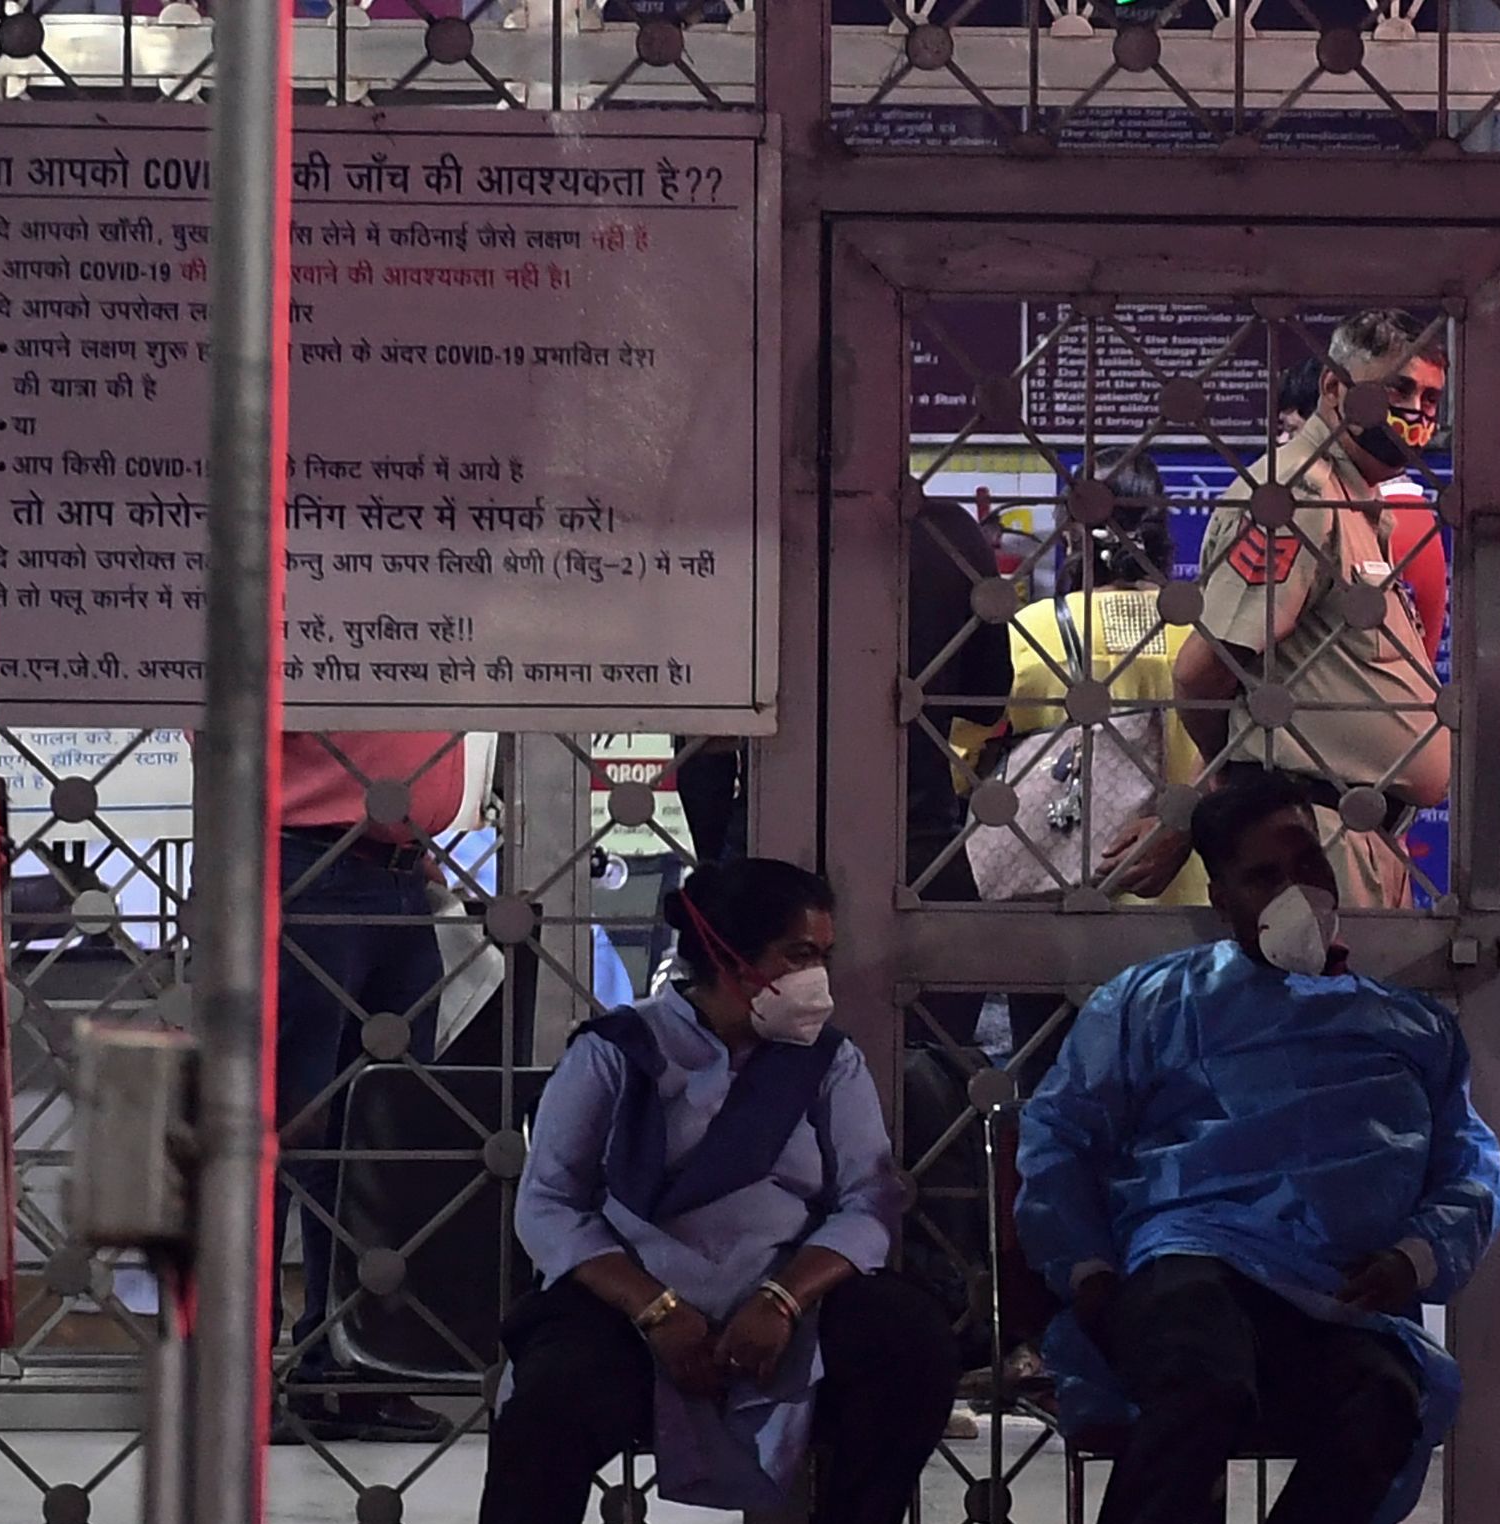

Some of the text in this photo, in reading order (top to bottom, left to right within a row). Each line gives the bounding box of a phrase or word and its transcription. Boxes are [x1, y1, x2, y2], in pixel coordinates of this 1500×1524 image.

[28, 147, 129, 188] आपको
[144, 158, 209, 190] COVI
[423, 153, 462, 195] की
[477, 164, 644, 198] आवश्यकता
[21, 214, 88, 241] आपको
[321, 219, 356, 246] लेने
[366, 219, 380, 247] में
[389, 220, 468, 252] कठिनाई
[477, 221, 516, 249] जैसे
[525, 228, 581, 249] लक्षण
[2, 255, 71, 282] आपको
[79, 260, 172, 283] COVID-19
[347, 258, 374, 286] की
[383, 264, 495, 289] आवश्यकता
[22, 292, 90, 320] आपको
[100, 294, 179, 322] उपरोक्त
[14, 331, 71, 359] आपने
[80, 338, 136, 360] लक्षण
[351, 336, 372, 365] के
[435, 342, 526, 367] COVID-19
[13, 369, 40, 397] की
[51, 377, 97, 399] यात्रा
[105, 371, 134, 399] की
[12, 415, 37, 436] या
[12, 455, 53, 477] आप
[62, 450, 116, 477] किसी
[306, 453, 362, 480] निकट
[370, 454, 426, 481] संपर्क
[433, 454, 449, 482] में
[10, 489, 46, 528] तो
[56, 499, 115, 528] आप
[356, 493, 425, 531] सेंटर
[433, 495, 457, 533] में
[468, 495, 545, 534] संपर्क
[17, 542, 87, 570] आपको
[94, 544, 176, 572] उपरोक्त
[333, 553, 373, 574] आप
[380, 553, 431, 574] ऊपर
[438, 547, 493, 577] लिखी
[655, 549, 671, 578] में
[16, 581, 41, 609] तो
[156, 584, 173, 610] में
[343, 613, 419, 650] सुरक्षित
[369, 661, 429, 682] स्वस्थ
[438, 656, 476, 685] होने
[485, 656, 514, 684] की
[524, 662, 593, 684] कामना
[602, 662, 660, 685] करता
